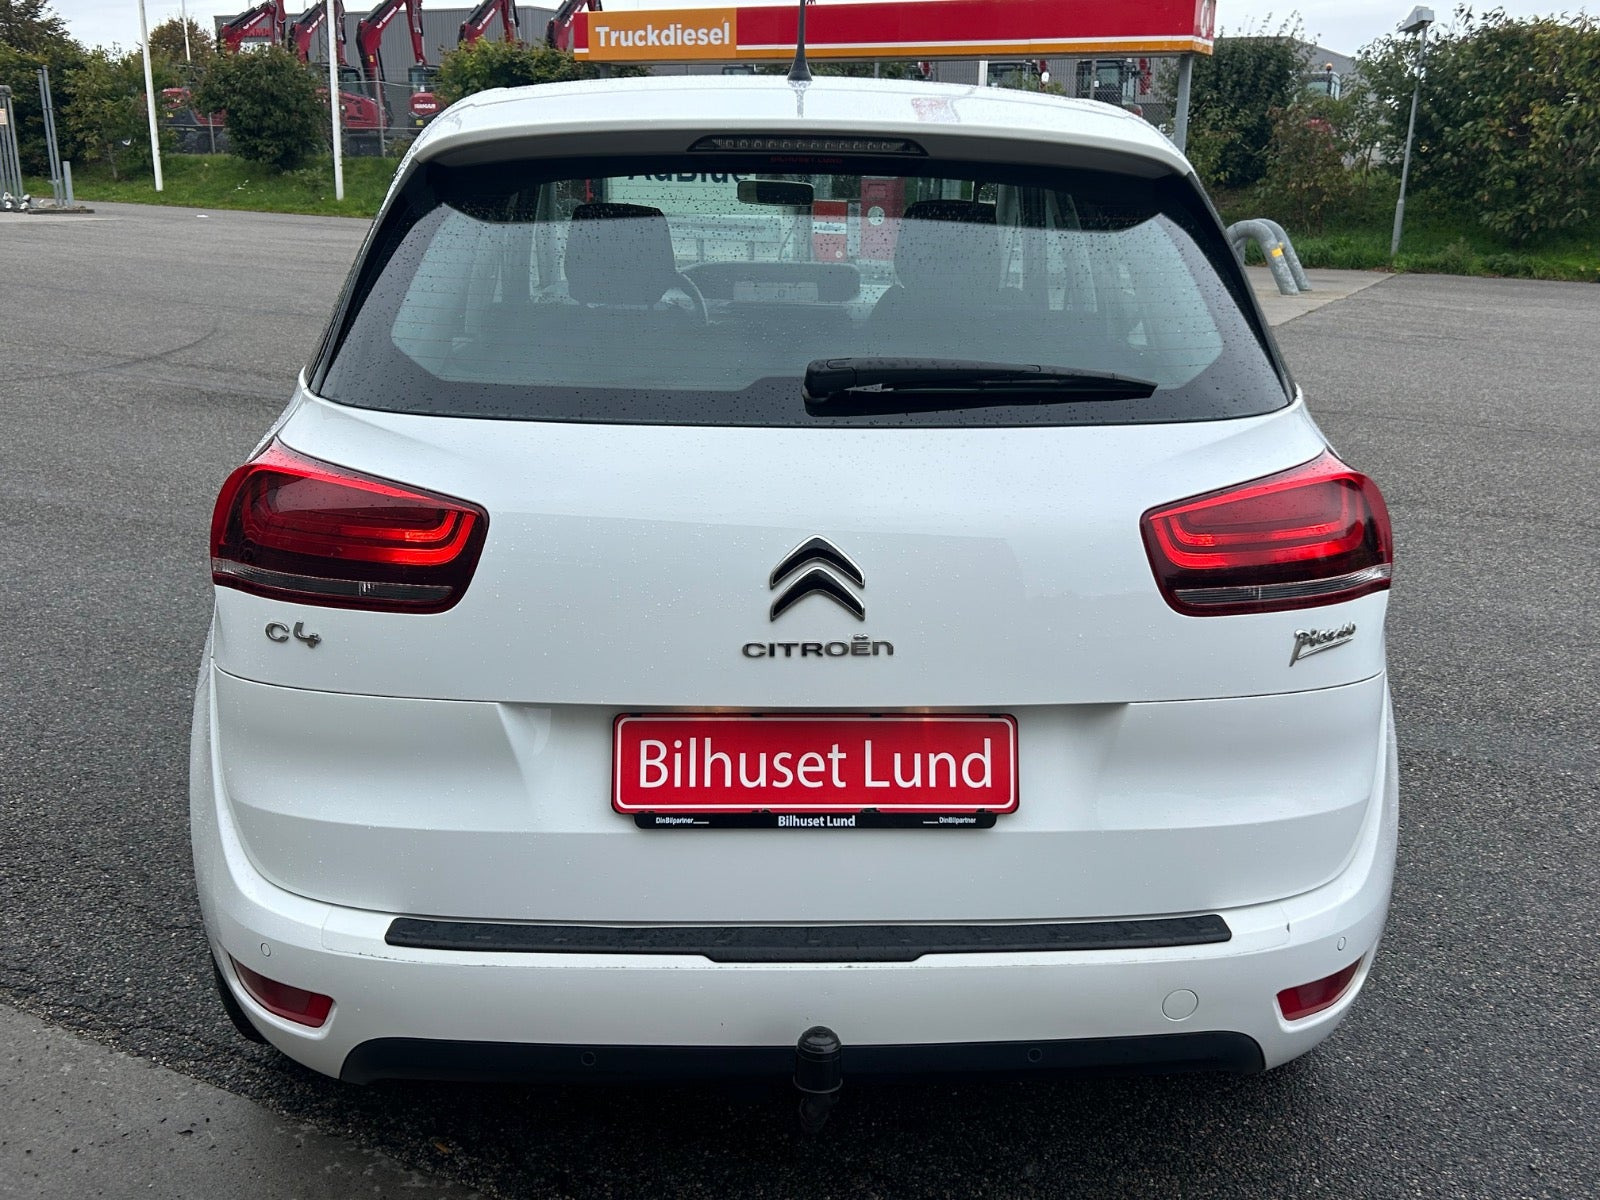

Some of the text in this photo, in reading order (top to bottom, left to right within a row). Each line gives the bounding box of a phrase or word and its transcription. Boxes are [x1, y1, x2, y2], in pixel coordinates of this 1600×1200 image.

[595, 22, 730, 47] Truckdiesel
[265, 621, 322, 649] C4
[639, 737, 993, 788] Bilhuset Lund
[778, 814, 856, 827] Bilhuset Lund
